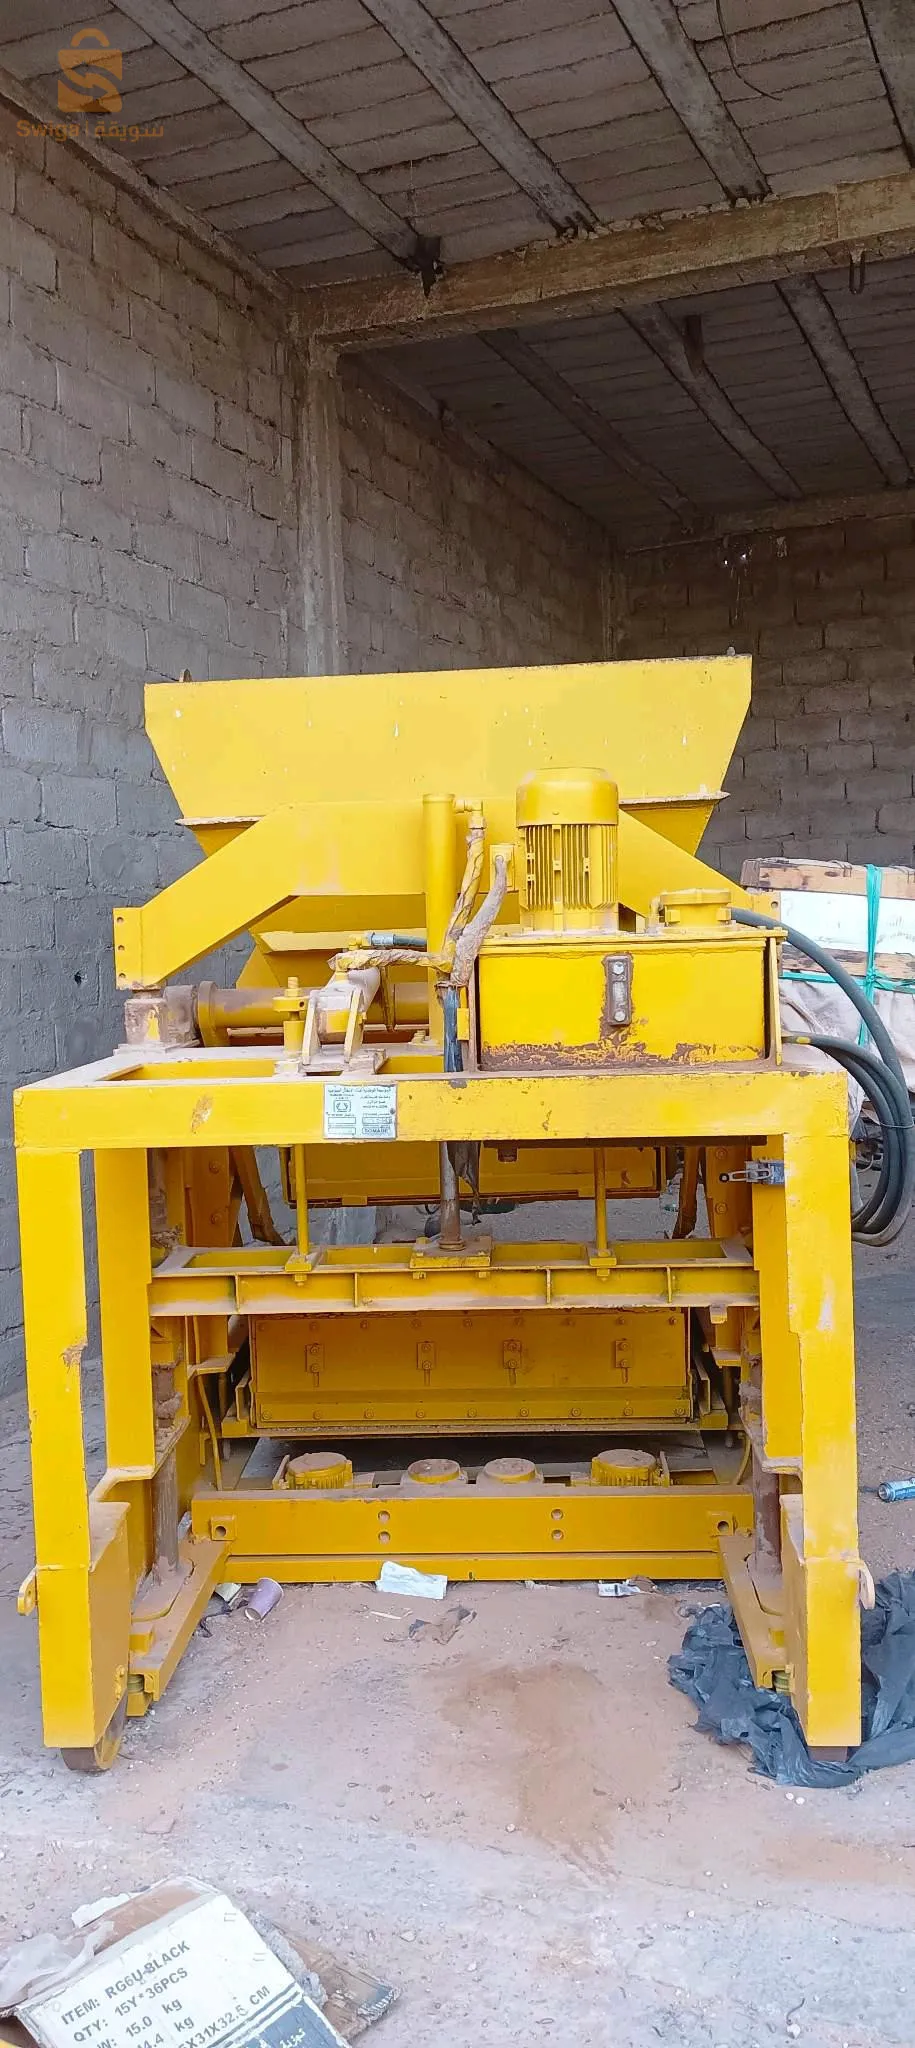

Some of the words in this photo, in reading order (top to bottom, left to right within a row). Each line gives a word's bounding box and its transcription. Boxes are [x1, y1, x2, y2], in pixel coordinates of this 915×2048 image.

[61, 1998, 101, 2025] ITEM:
[105, 1940, 190, 1999] RG6U-BLACK
[249, 1985, 271, 2006] CM
[126, 2015, 153, 2037] 15.0
[162, 1998, 183, 2014] kg
[174, 2016, 195, 2032] kg
[73, 2019, 108, 2042] QTY:
